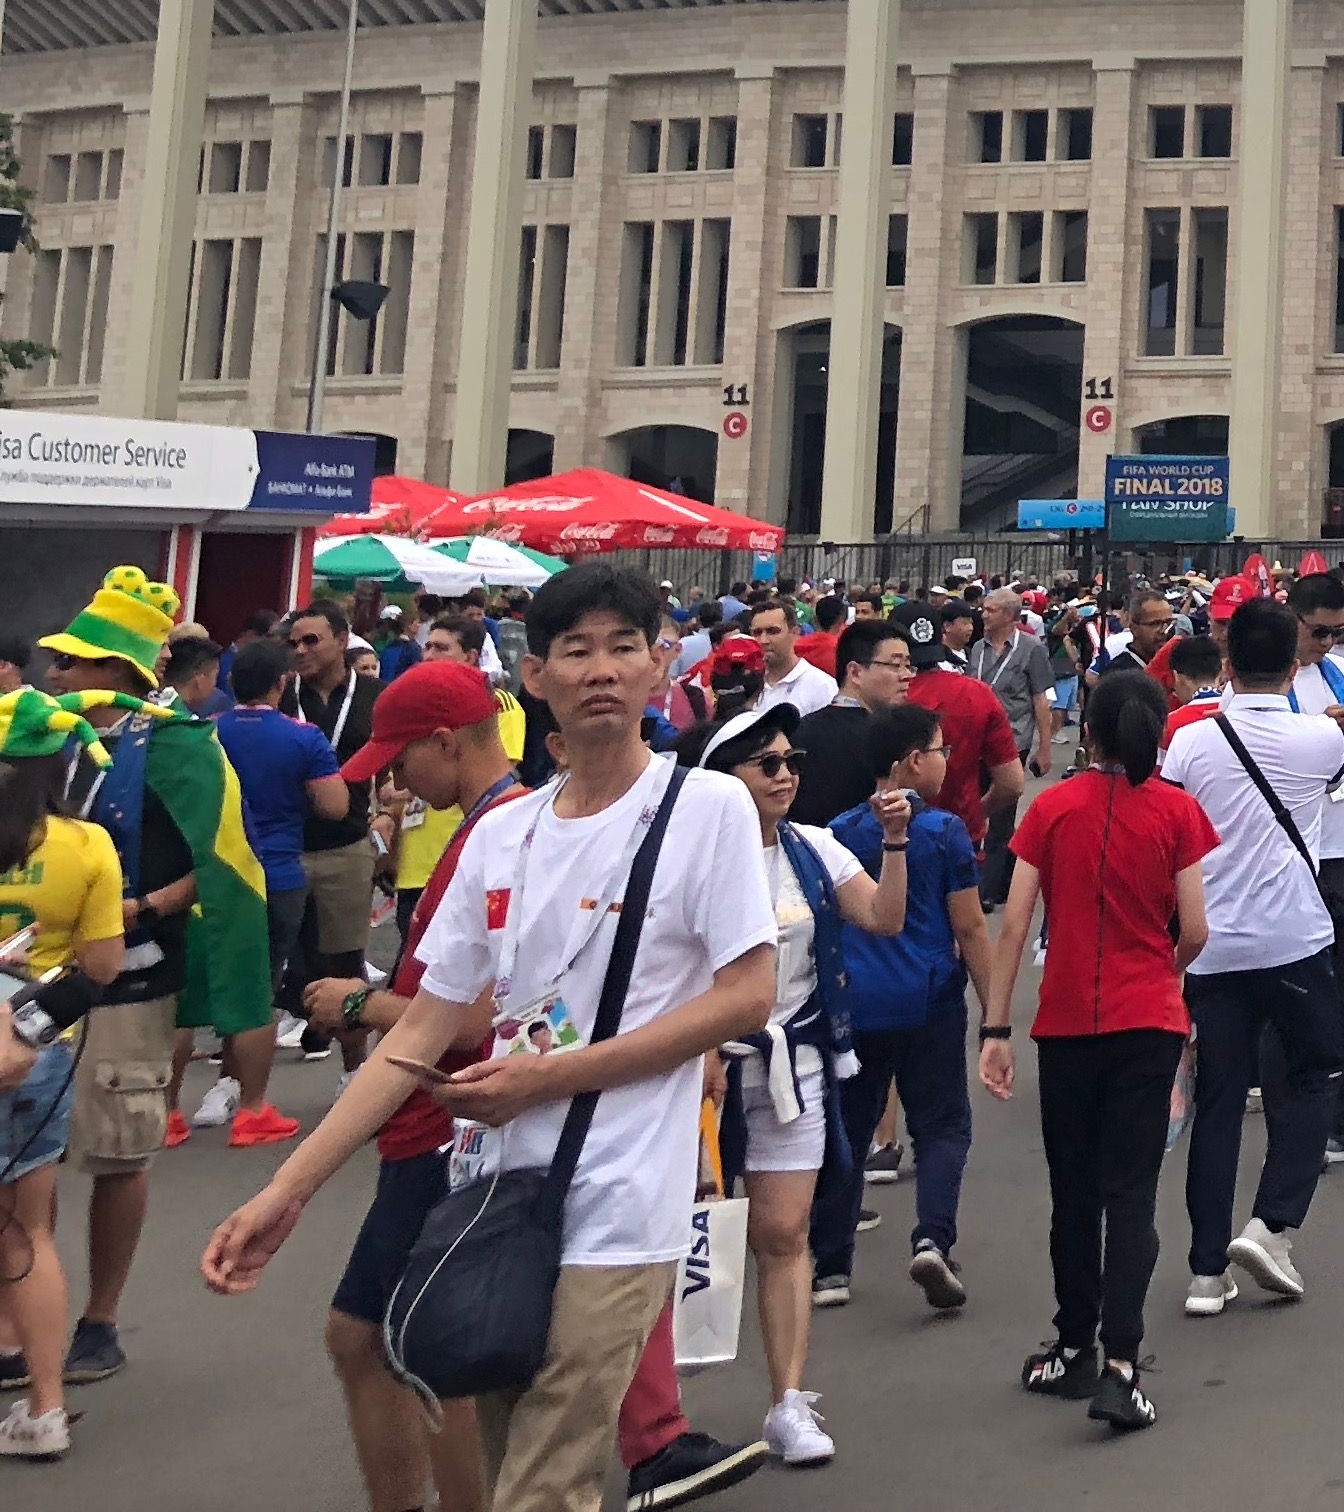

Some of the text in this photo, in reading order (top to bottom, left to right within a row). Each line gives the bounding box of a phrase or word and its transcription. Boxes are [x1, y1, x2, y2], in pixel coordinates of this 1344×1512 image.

[723, 384, 750, 406] 11
[1085, 377, 1114, 399] 11
[29, 432, 120, 465] Customer
[124, 438, 187, 469] Service
[1123, 465, 1214, 475] FIFA WORLD CUP
[1114, 478, 1223, 496] FINAL 2018
[681, 1209, 711, 1303] VISA
